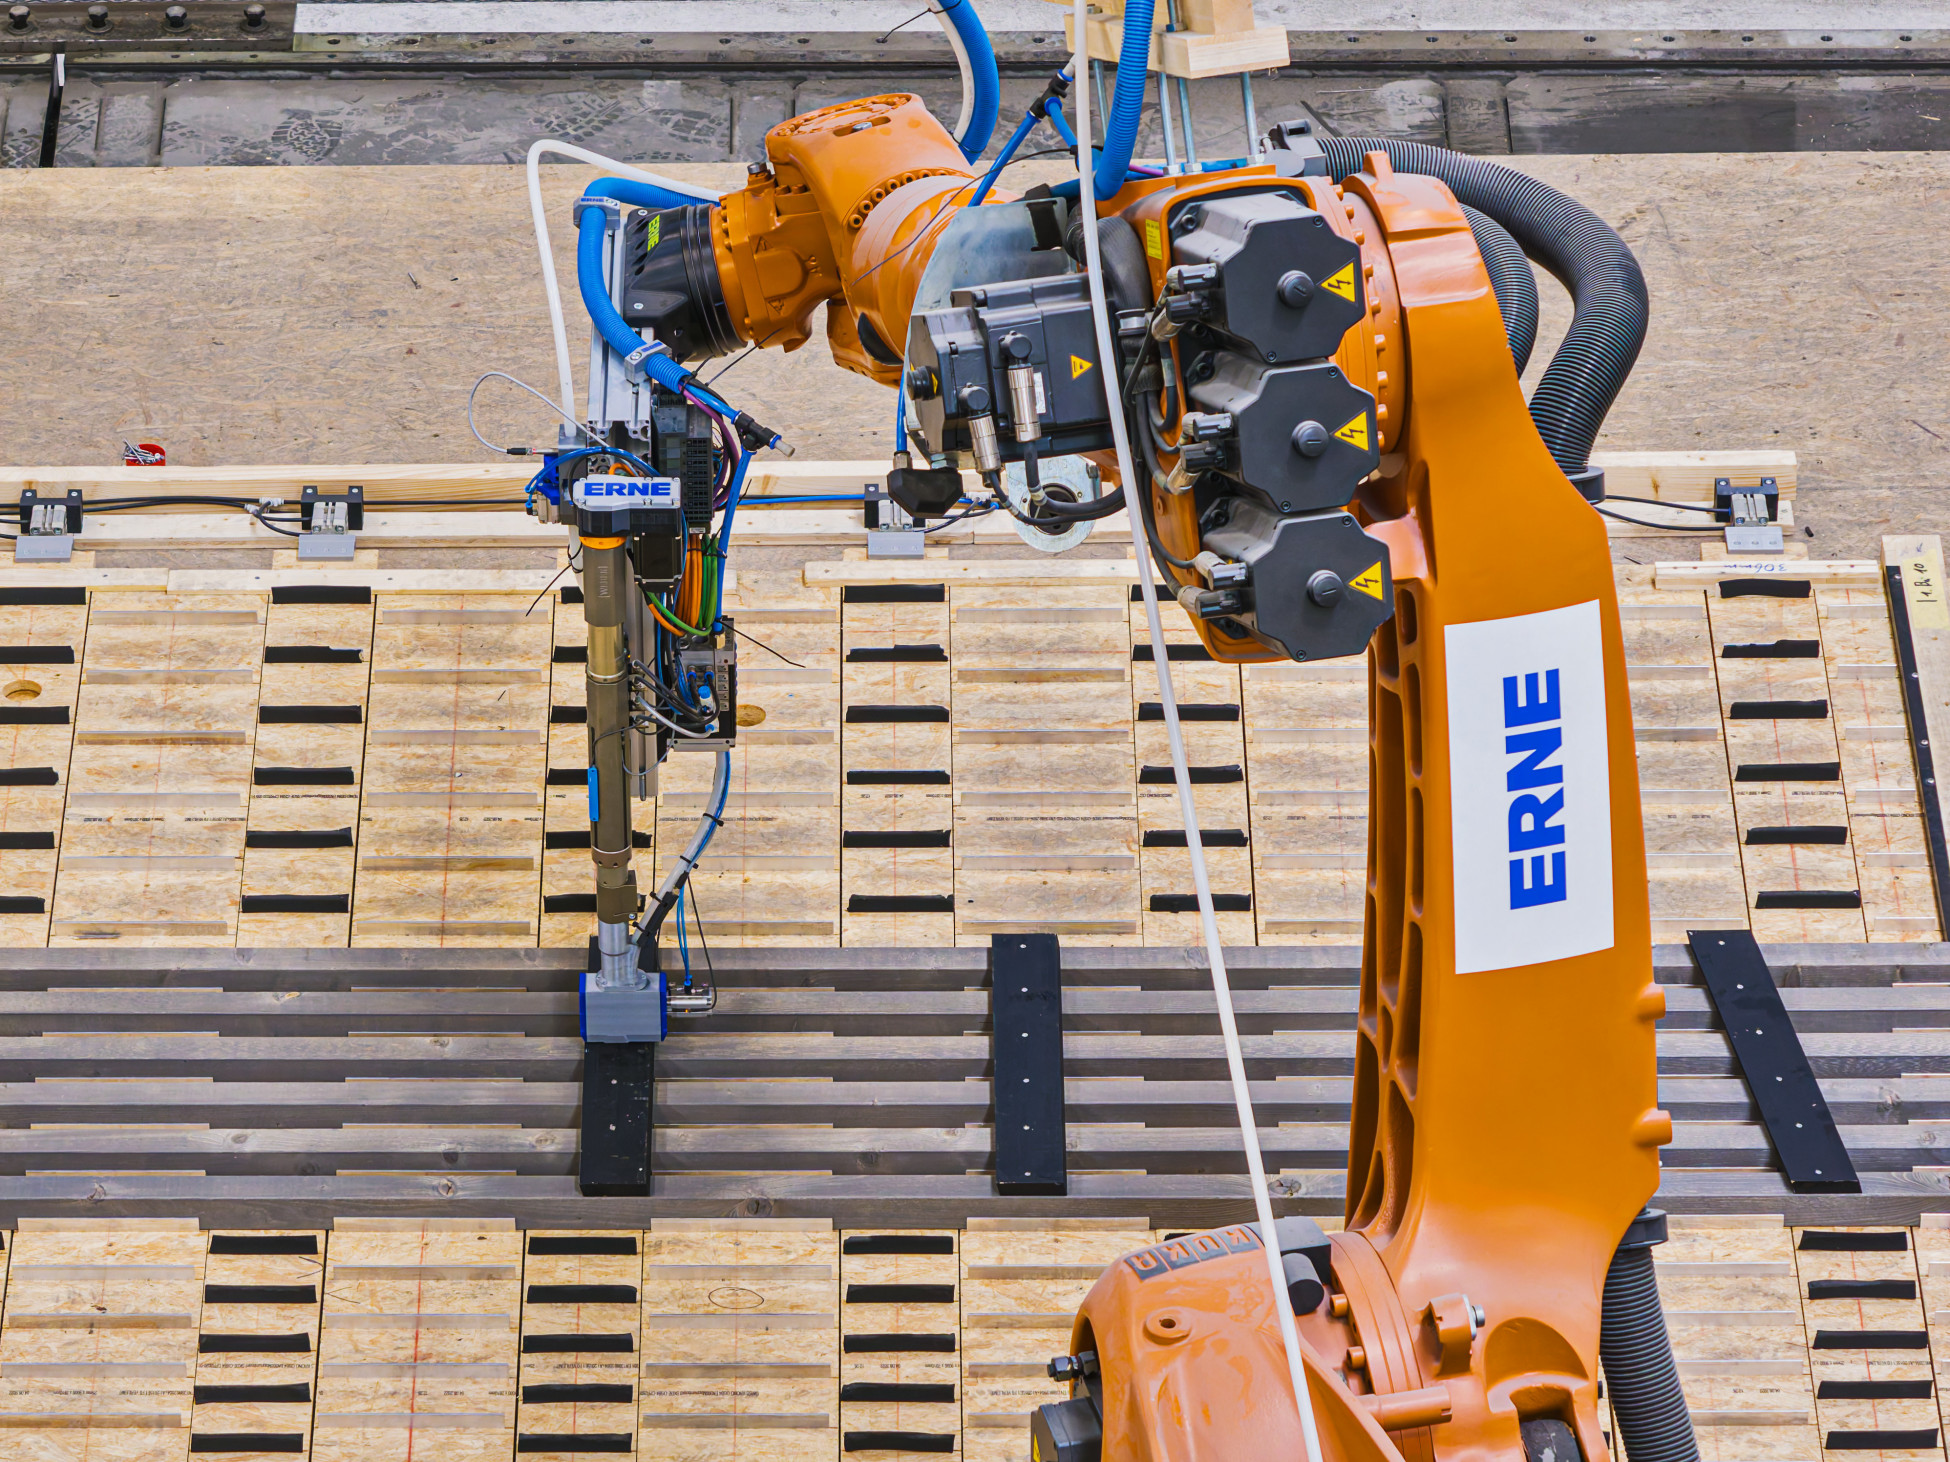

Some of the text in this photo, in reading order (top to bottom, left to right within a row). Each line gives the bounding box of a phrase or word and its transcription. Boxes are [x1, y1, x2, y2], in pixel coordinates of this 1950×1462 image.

[584, 482, 671, 496] ERNE
[1723, 562, 1788, 574] 306mm
[1913, 563, 1928, 574] 10
[1503, 668, 1567, 910] ERNE
[1130, 1227, 1251, 1271] KUKA
